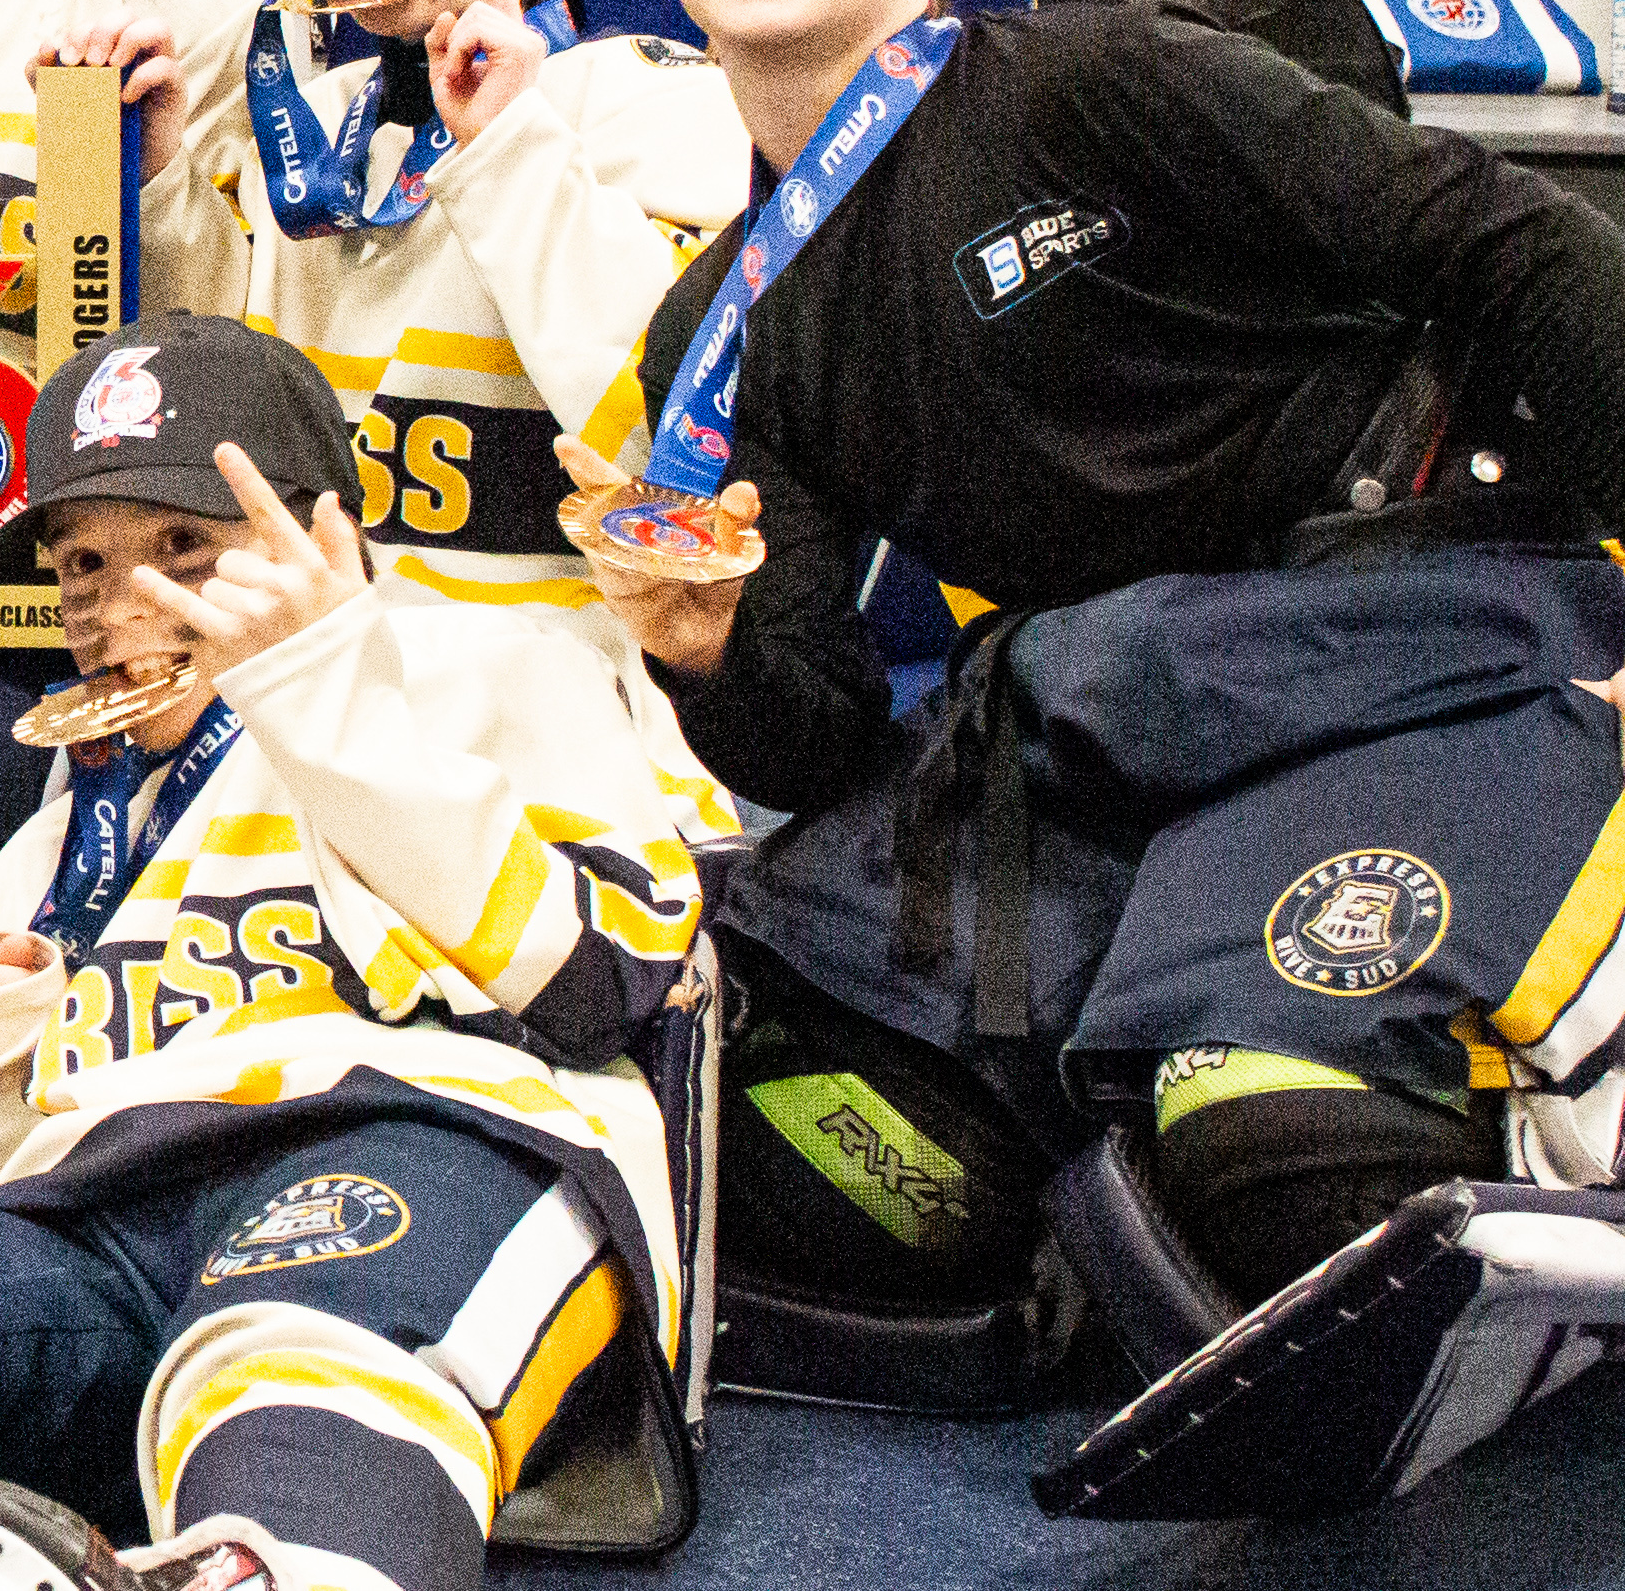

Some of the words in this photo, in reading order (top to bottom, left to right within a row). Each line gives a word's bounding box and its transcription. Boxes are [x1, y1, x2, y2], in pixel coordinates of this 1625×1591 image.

[820, 91, 888, 178] CATELLI
[1028, 220, 1109, 271] SPORTS
[72, 232, 110, 352] OGERS
[0, 604, 65, 629] CLASS
[175, 707, 244, 786] ATELLI
[1314, 855, 1439, 901] EXPRESS
[1274, 935, 1313, 978] RIVE
[1344, 958, 1399, 990] SUD
